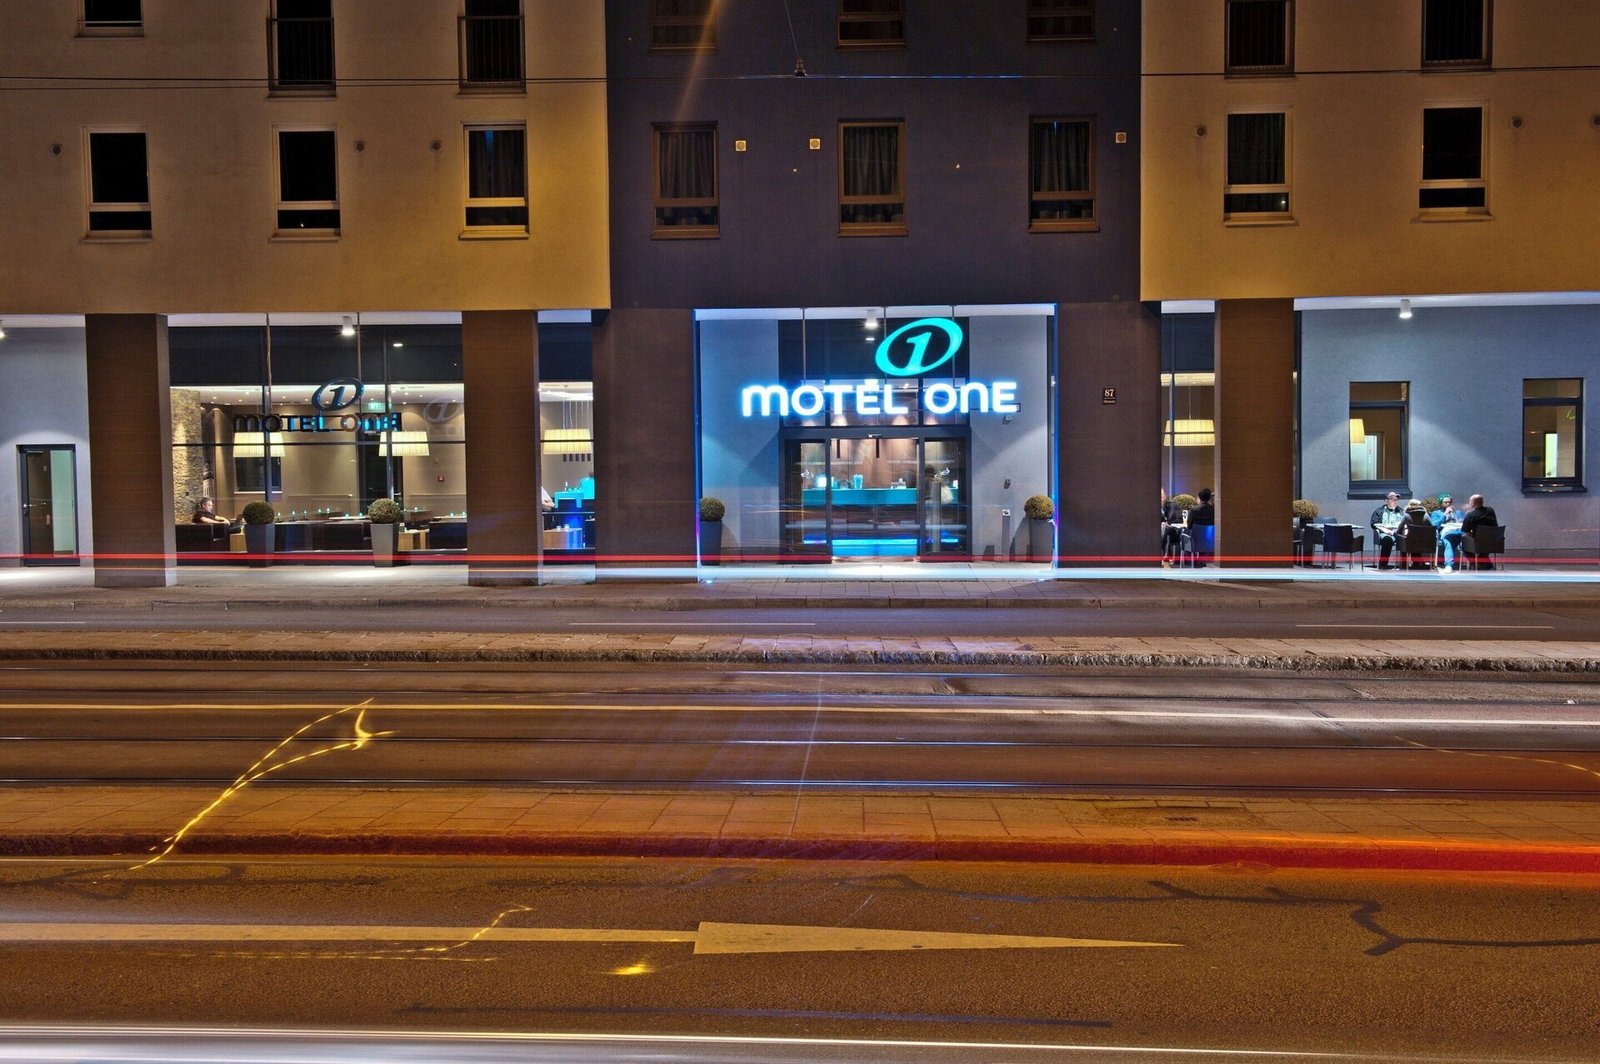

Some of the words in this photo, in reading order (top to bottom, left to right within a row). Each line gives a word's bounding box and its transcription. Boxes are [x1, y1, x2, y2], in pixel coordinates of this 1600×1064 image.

[741, 382, 909, 417] MOTEL
[923, 381, 1018, 414] ONE
[1104, 388, 1115, 398] 87
[233, 413, 334, 432] MOTEL
[340, 413, 402, 432] ONE
